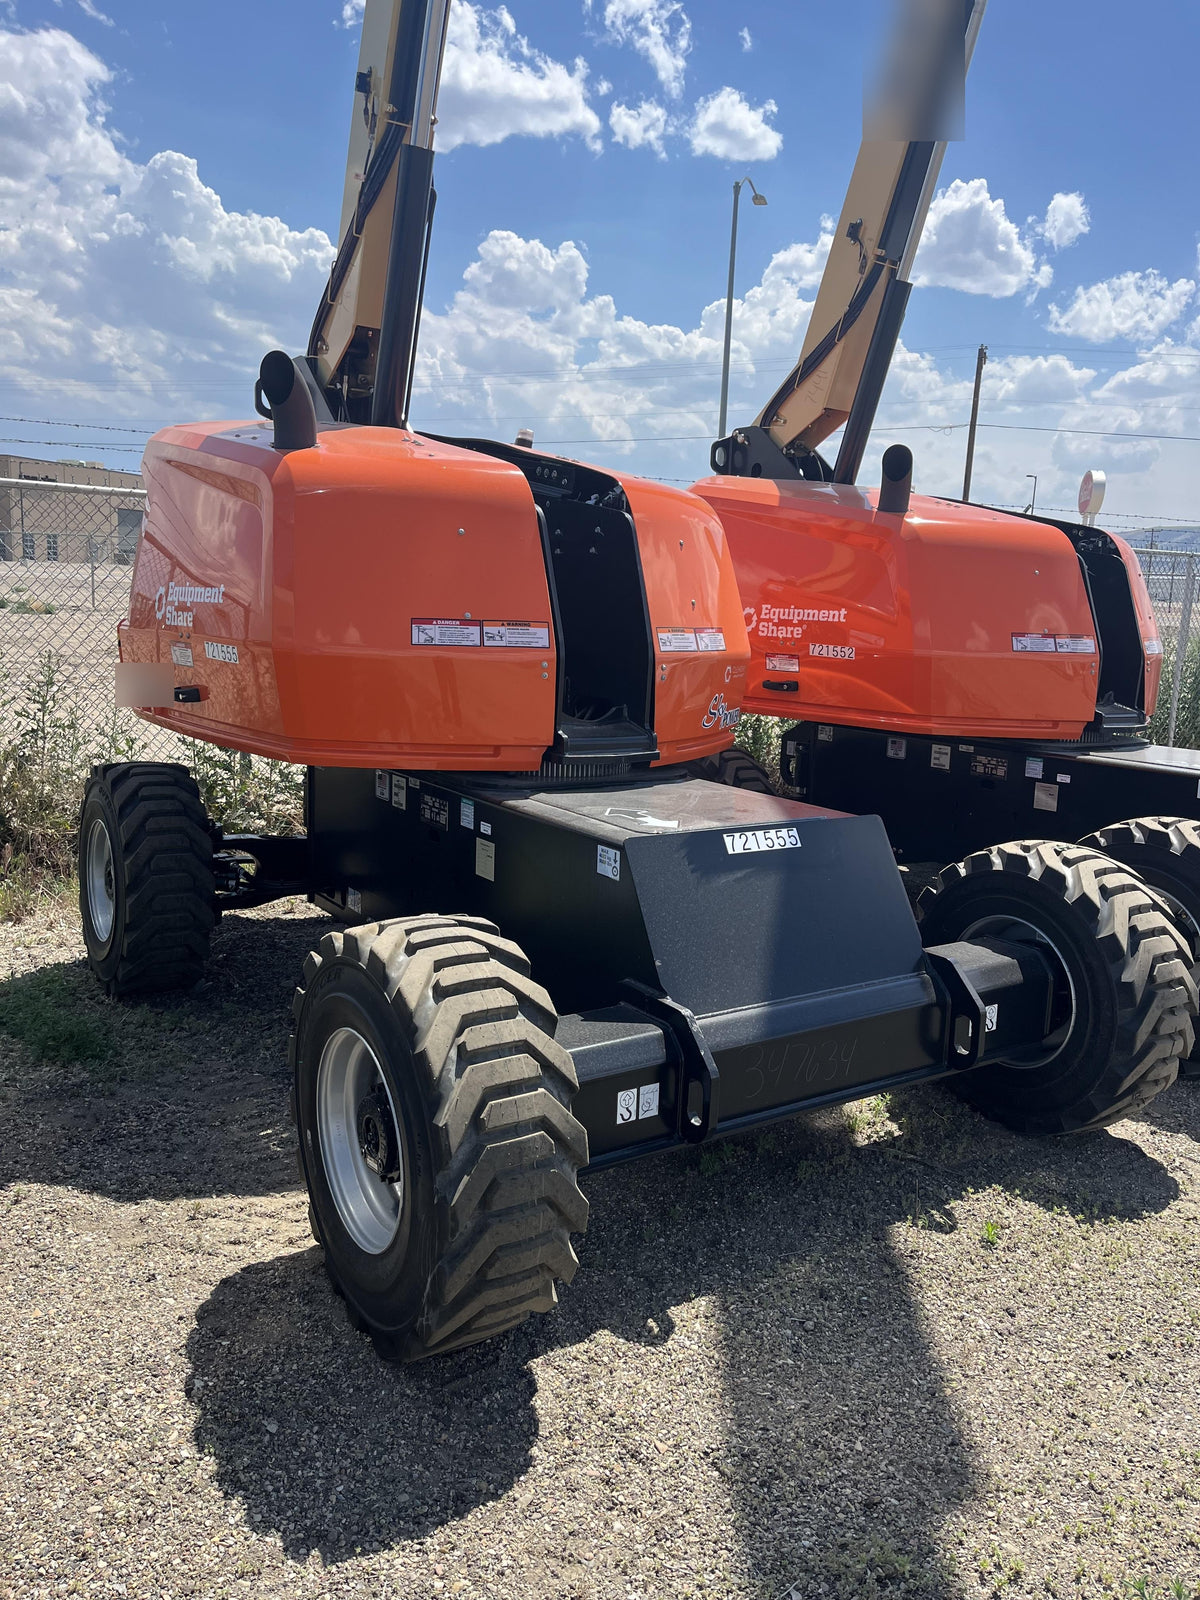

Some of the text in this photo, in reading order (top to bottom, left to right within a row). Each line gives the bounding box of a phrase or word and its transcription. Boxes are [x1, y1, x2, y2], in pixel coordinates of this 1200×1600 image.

[167, 581, 225, 606] Equipment
[165, 605, 193, 627] Share
[760, 604, 847, 623] Equipment
[758, 622, 803, 638] Share
[205, 642, 238, 662] 721555
[811, 643, 855, 659] 721552
[725, 828, 800, 852] 721555
